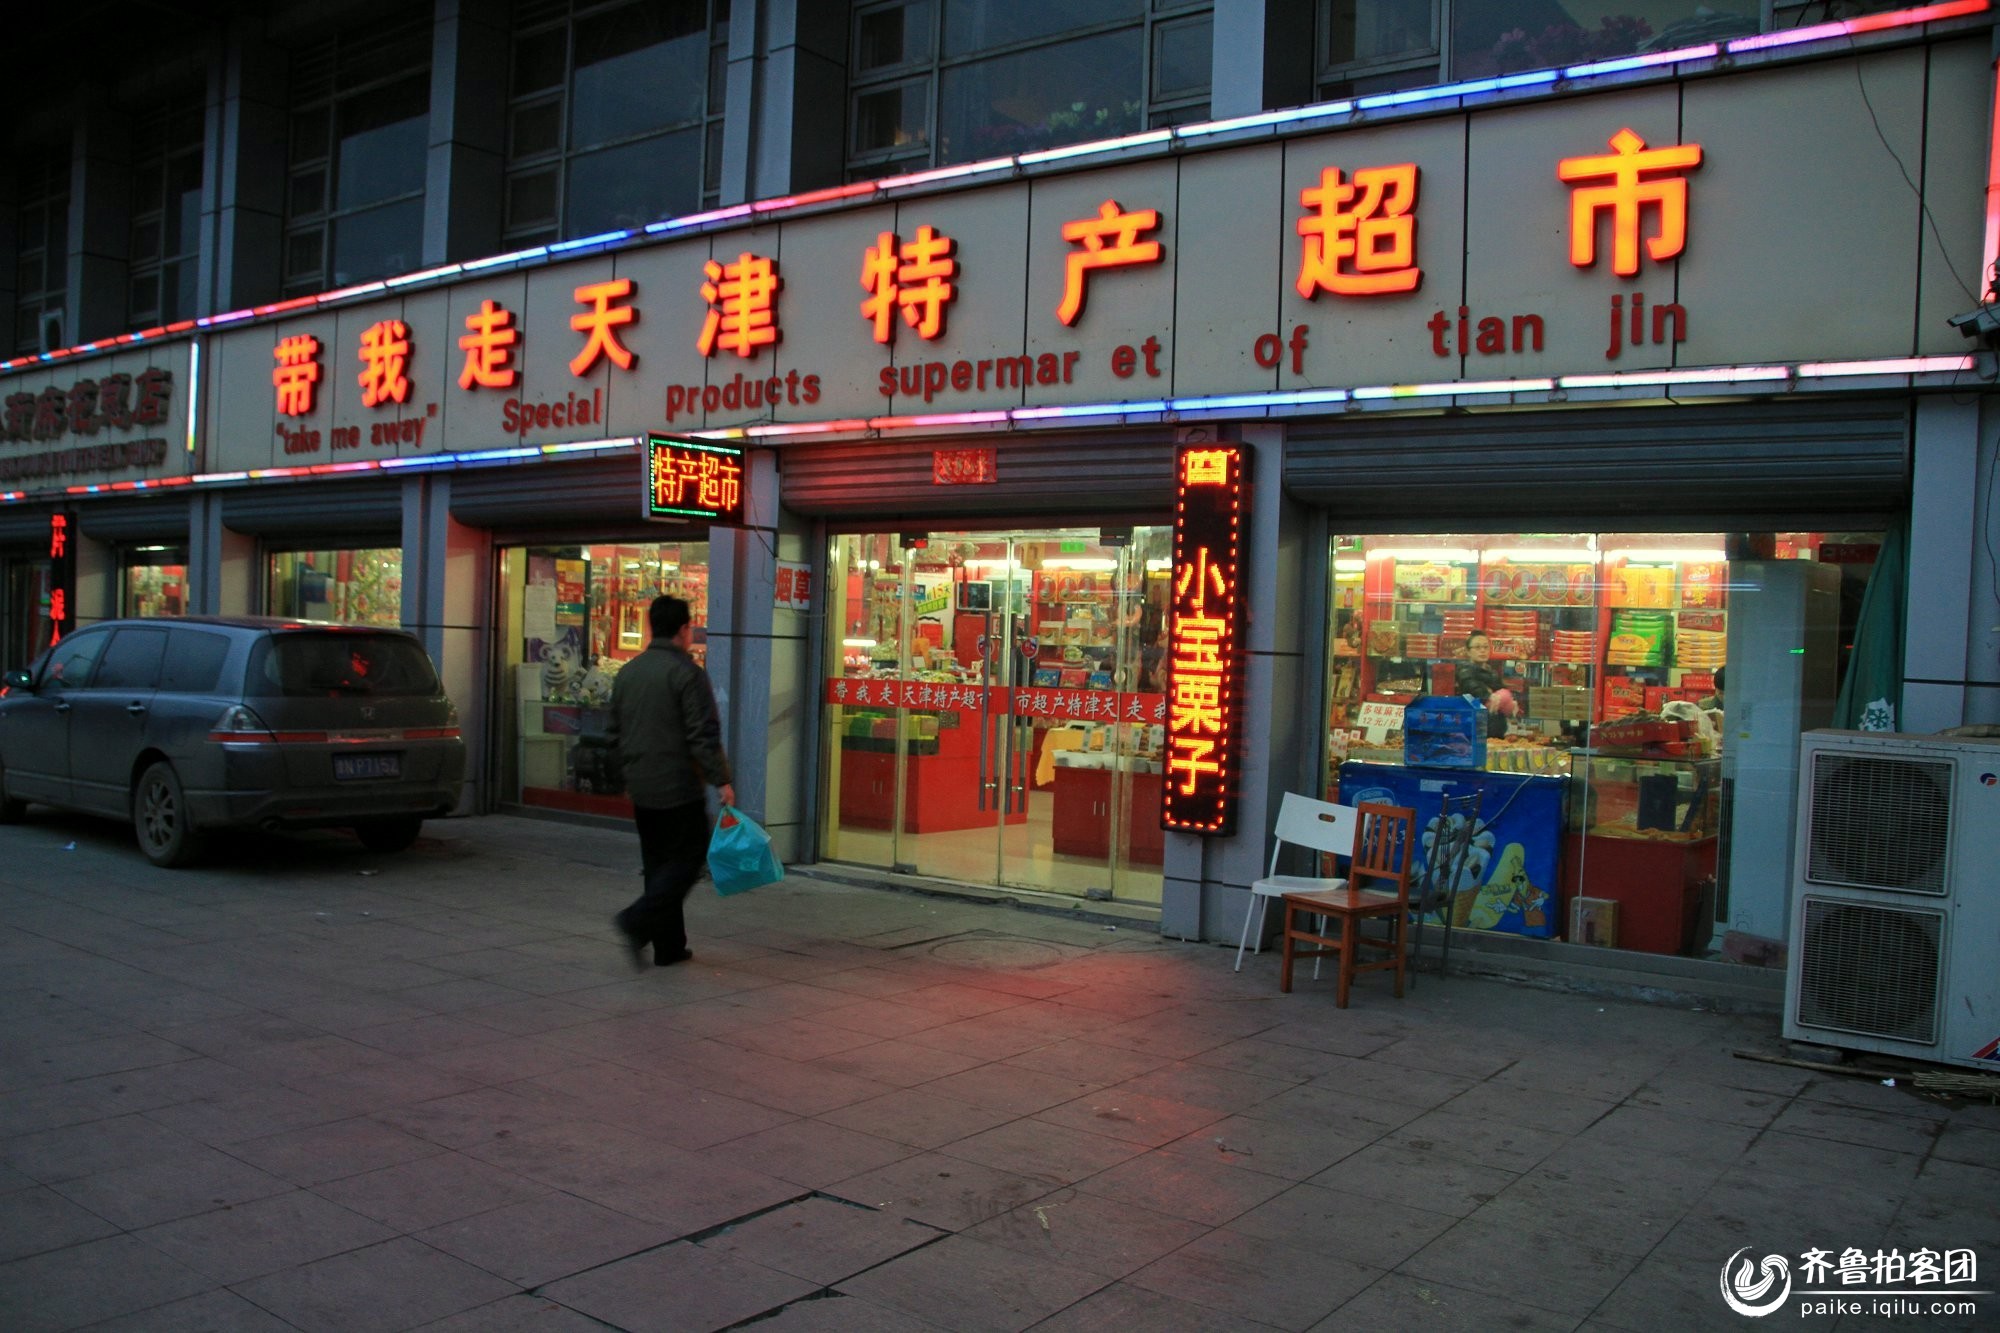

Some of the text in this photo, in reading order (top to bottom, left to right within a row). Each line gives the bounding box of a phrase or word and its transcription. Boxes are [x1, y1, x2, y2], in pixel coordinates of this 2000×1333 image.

[273, 127, 1703, 417] 带我走天津特产超市
[330, 422, 361, 449] me
[502, 388, 601, 437] Special
[666, 369, 821, 422] products
[1253, 324, 1309, 374] of
[1428, 305, 1545, 358] tian
[1606, 292, 1687, 360] jin
[654, 446, 741, 511] 特产超市
[1170, 547, 1226, 796] 小宝栗子
